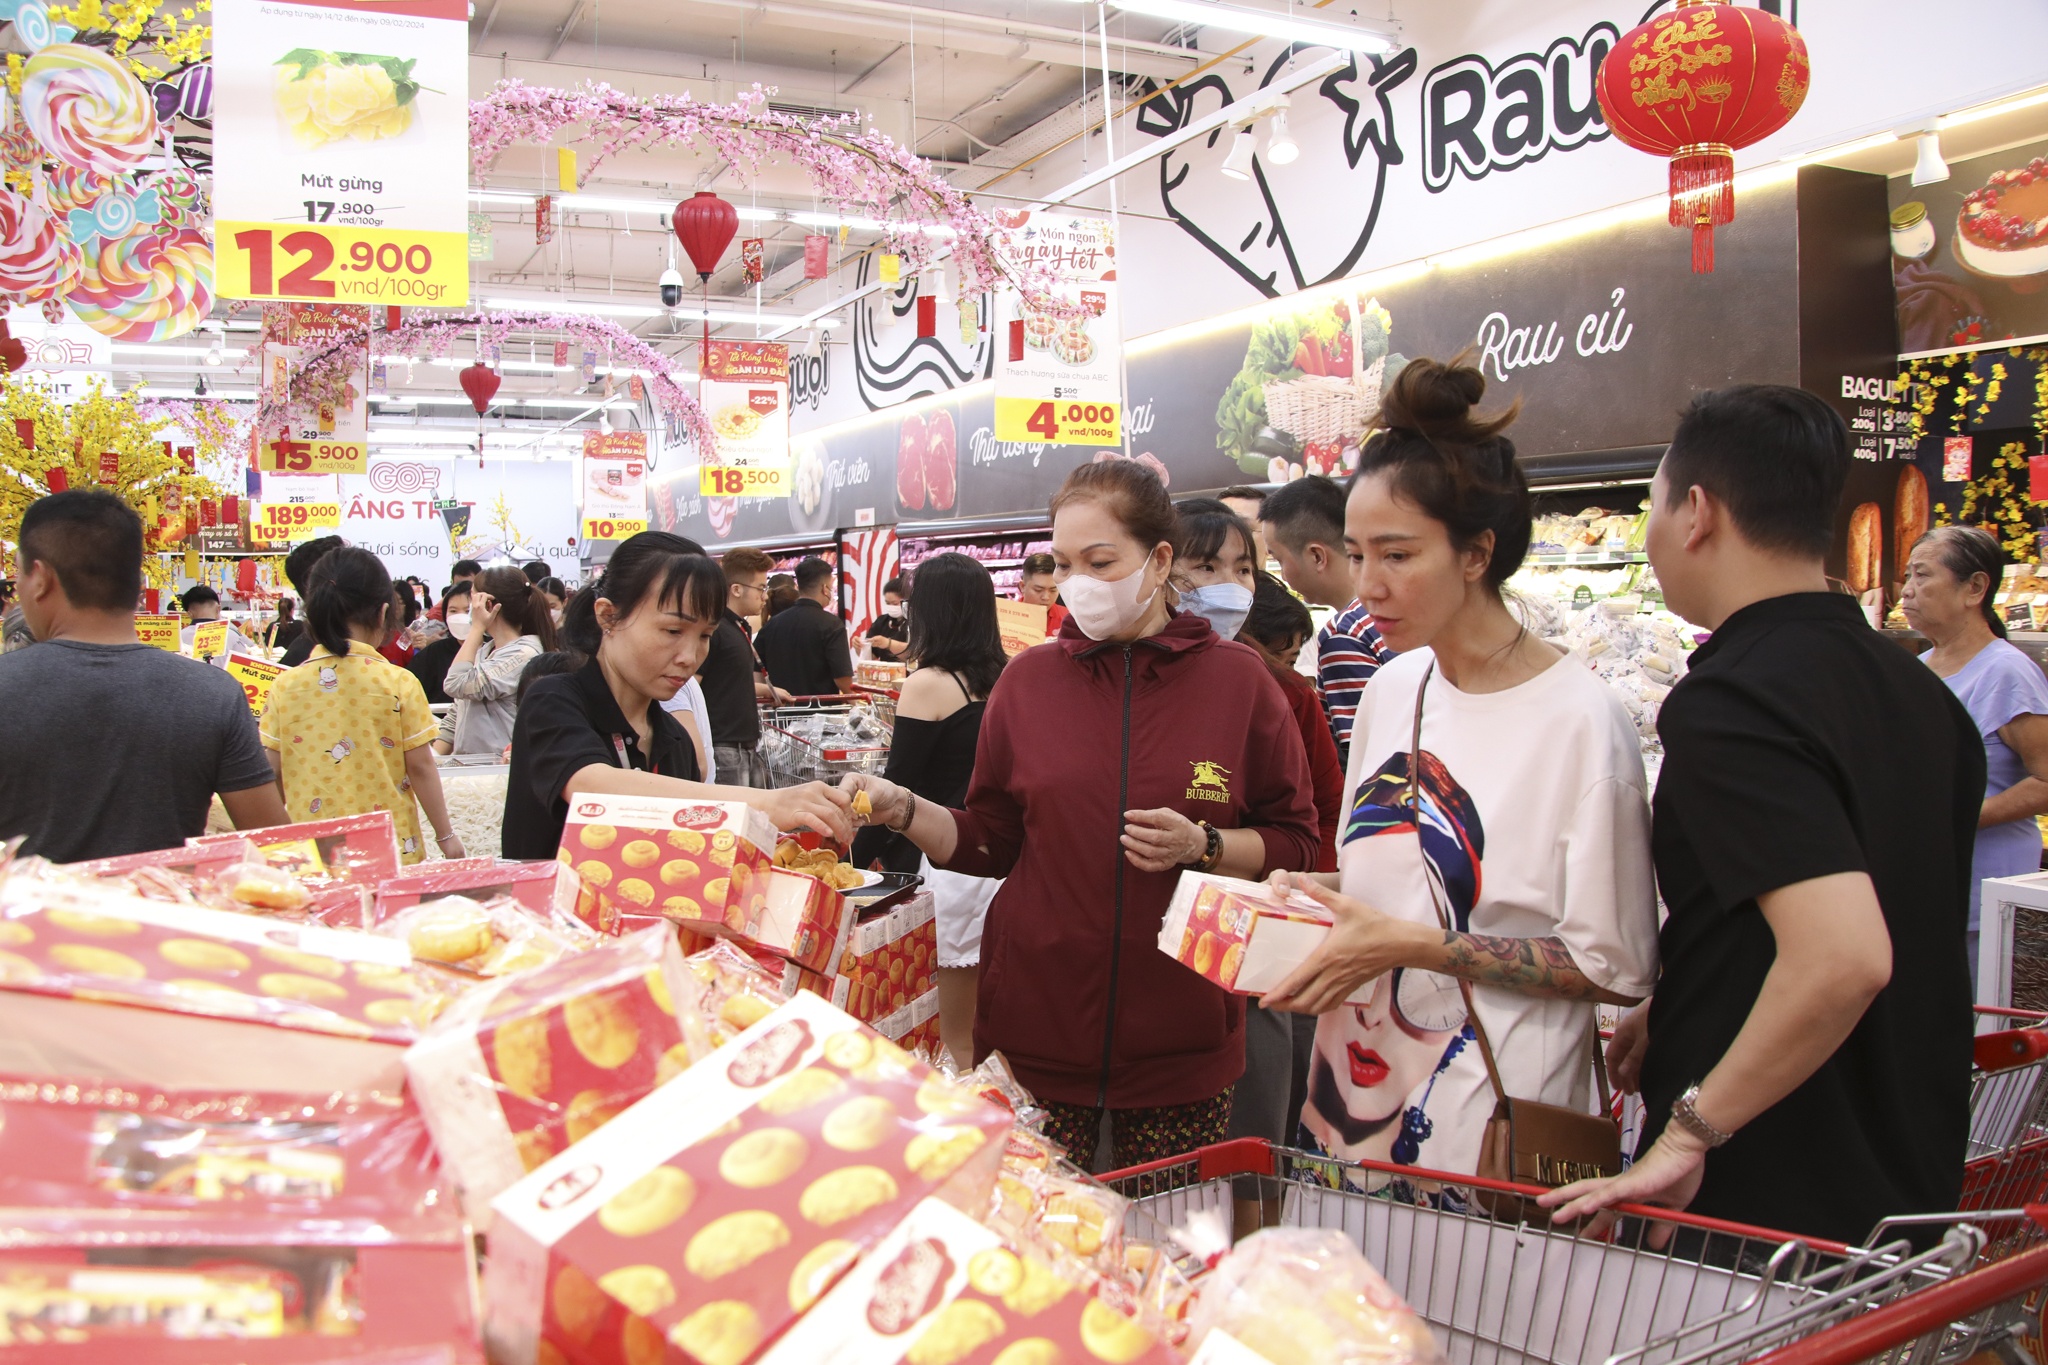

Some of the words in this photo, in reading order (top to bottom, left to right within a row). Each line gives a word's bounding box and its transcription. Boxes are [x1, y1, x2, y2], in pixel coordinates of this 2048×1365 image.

[379, 19, 425, 29] 09/02/2024
[1421, 21, 1619, 194] Rau
[301, 174, 334, 189] Mứt
[339, 175, 383, 194] gừng
[338, 216, 384, 227] vnd/100gr
[1039, 227, 1065, 241] Món
[1069, 231, 1096, 246] ngon
[341, 276, 447, 301] vnd/100gr
[1477, 311, 1564, 382] Rau
[1576, 287, 1633, 357] củ
[726, 365, 753, 376] NGÀN
[1092, 374, 1109, 382] ABC
[751, 396, 777, 405] -22%
[1851, 418, 1876, 432] 200g
[1853, 448, 1877, 462] 400g
[399, 541, 439, 558] sống
[1185, 788, 1231, 804] BURBERRY
